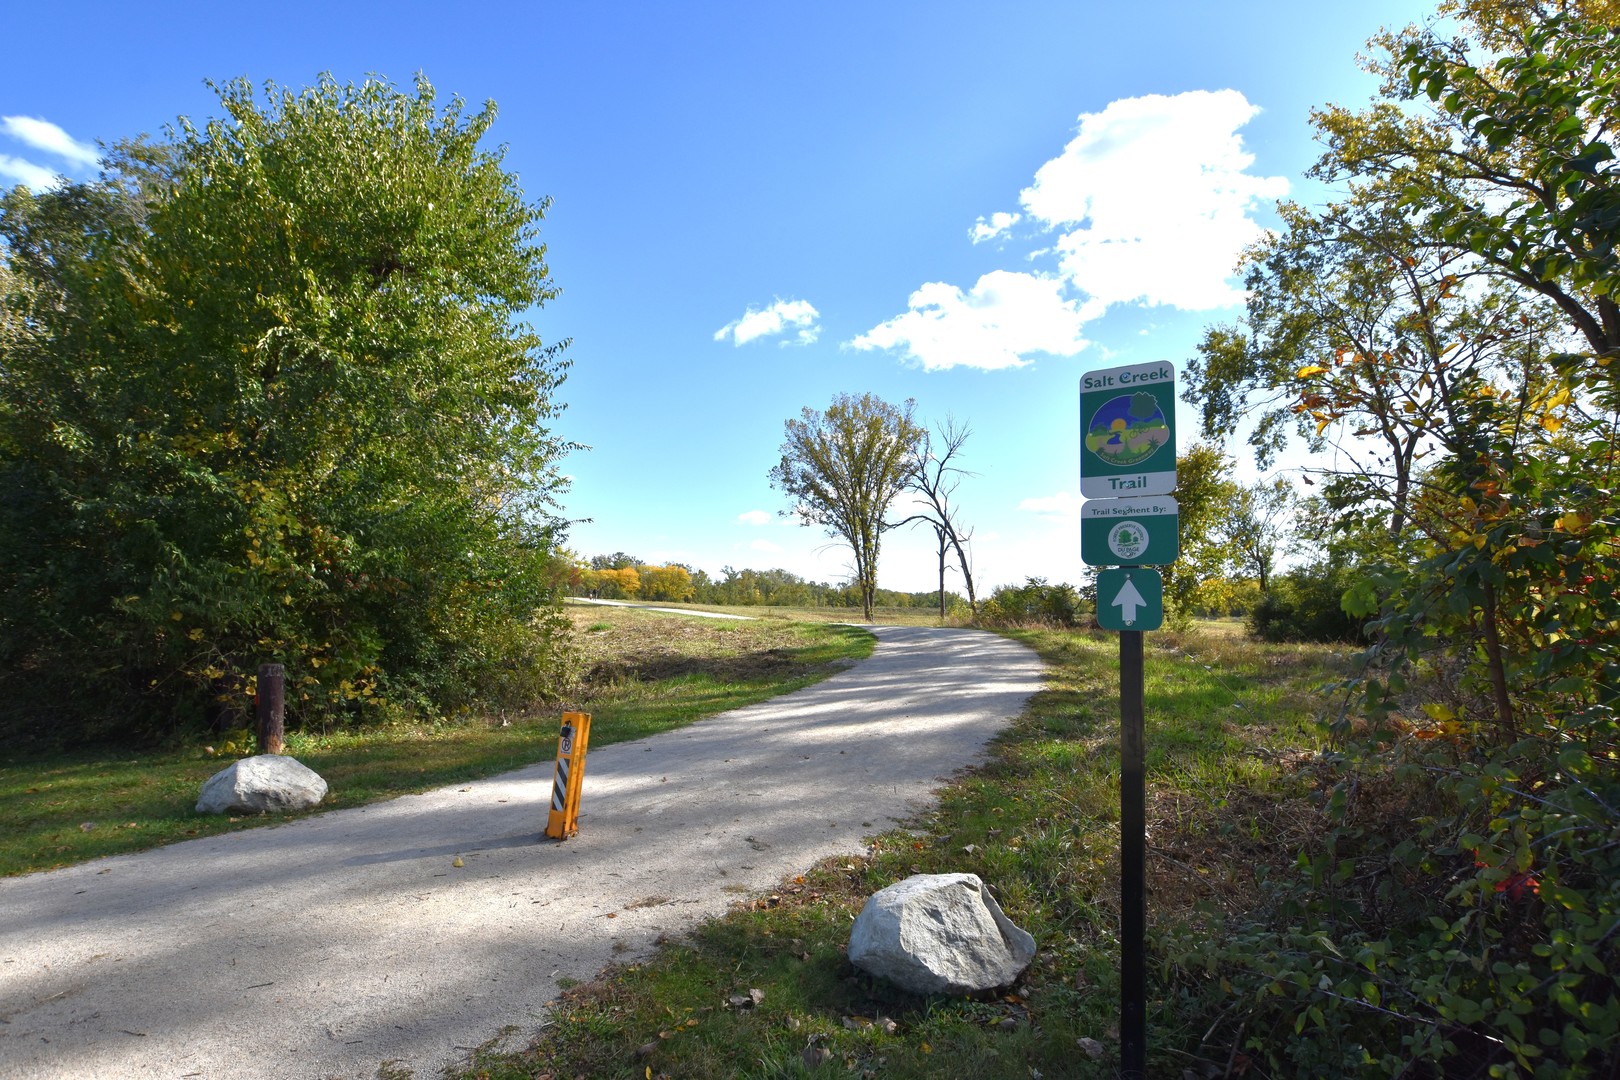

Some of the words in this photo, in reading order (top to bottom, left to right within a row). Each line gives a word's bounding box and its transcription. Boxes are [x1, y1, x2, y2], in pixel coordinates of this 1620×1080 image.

[1084, 376, 1114, 389] Salt
[1119, 368, 1168, 384] Creek
[1108, 476, 1147, 490] Trail
[1153, 506, 1167, 514] By:
